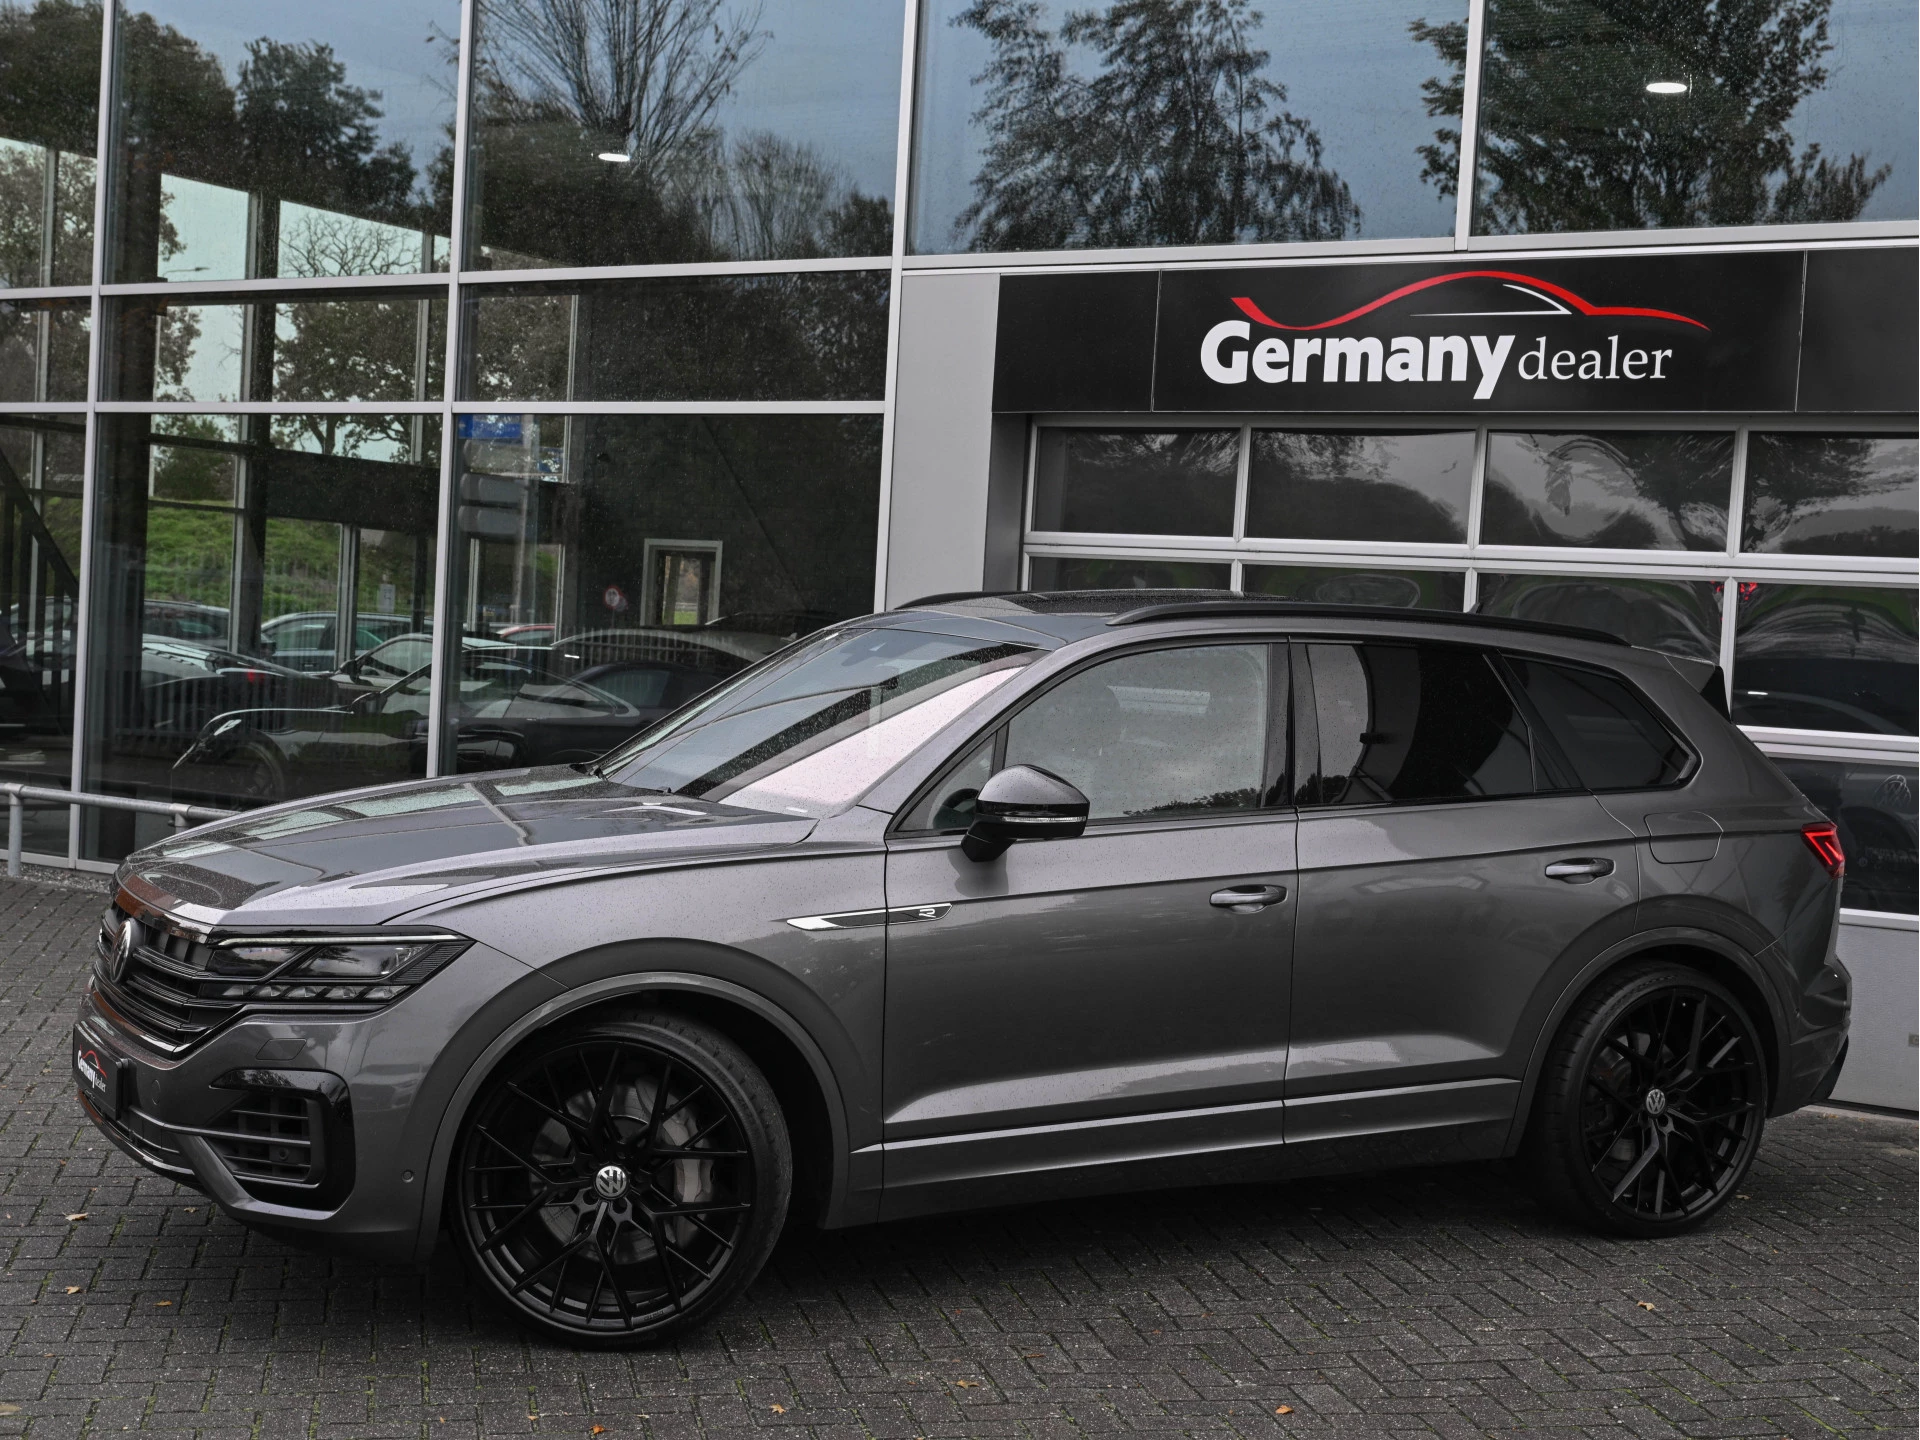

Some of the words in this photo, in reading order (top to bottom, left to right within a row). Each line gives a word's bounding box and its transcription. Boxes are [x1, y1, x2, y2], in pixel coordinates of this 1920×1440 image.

[1200, 320, 1515, 400] Germany
[1518, 336, 1673, 381] dealer
[596, 1166, 626, 1197] VW
